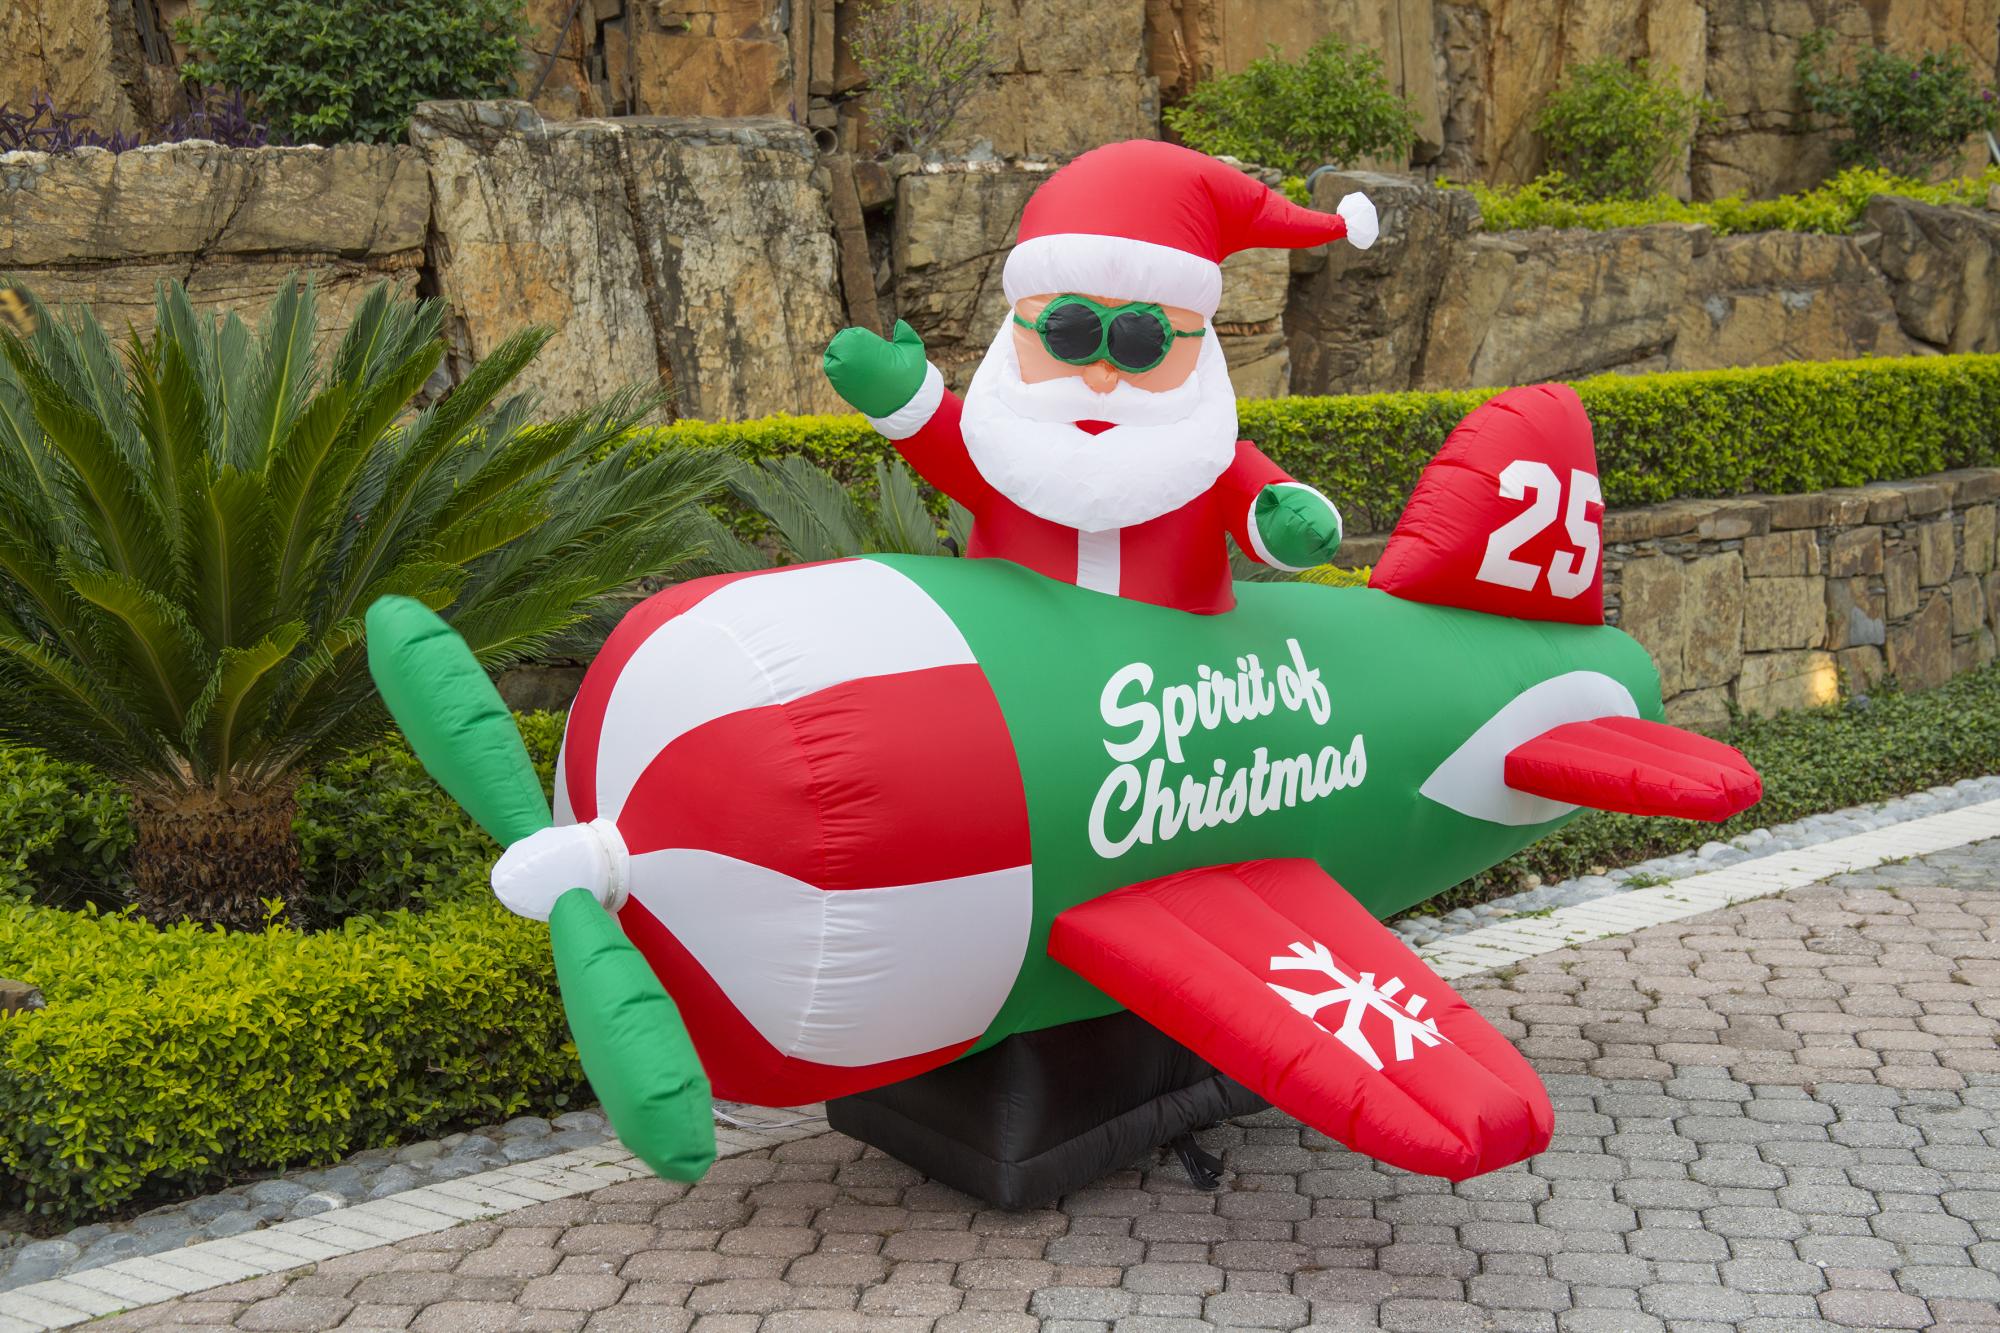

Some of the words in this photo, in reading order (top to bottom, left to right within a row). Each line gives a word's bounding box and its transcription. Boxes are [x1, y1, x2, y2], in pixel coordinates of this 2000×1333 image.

[1475, 459, 1604, 599] 25
[1100, 653, 1275, 763] Spirit
[1276, 638, 1331, 726] of
[1088, 734, 1367, 859] Christmas
